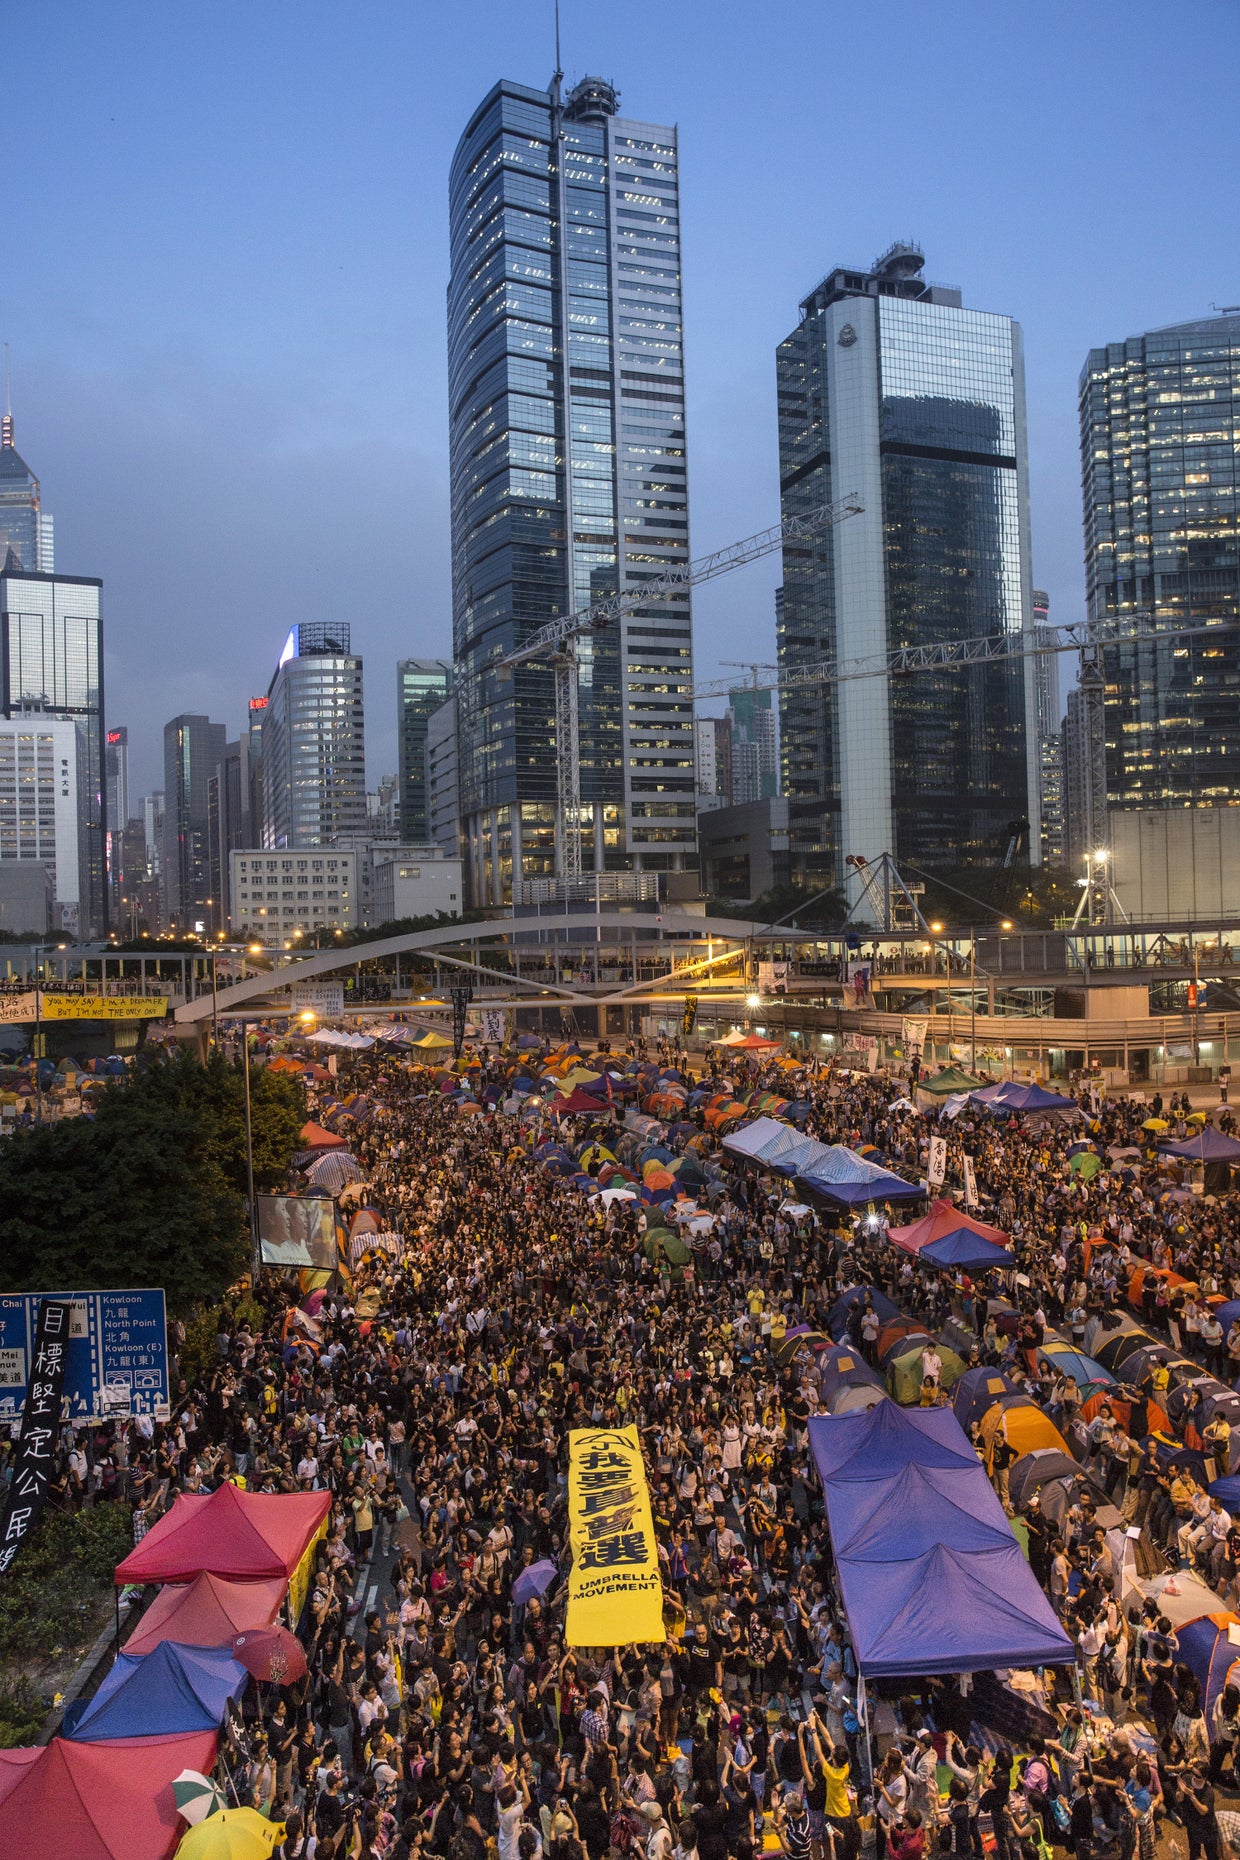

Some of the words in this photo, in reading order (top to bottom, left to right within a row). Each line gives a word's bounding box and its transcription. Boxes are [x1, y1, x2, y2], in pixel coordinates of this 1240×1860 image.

[120, 998, 127, 1006] A
[108, 1008, 124, 1017] THE
[126, 1008, 141, 1017] ONLY
[2, 1300, 23, 1308] Chai
[103, 1296, 142, 1304] Kowloon
[68, 1302, 86, 1310] Wui
[105, 1308, 129, 1319] 九龍
[71, 1323, 82, 1334] 道
[104, 1320, 131, 1329] North
[132, 1319, 157, 1328] Point
[105, 1331, 130, 1343] 北角
[105, 1344, 144, 1353] Kowloon
[146, 1343, 162, 1352] (E)
[2, 1352, 18, 1360] Mei
[579, 1573, 659, 1591] UMBRELLA
[573, 1582, 658, 1600] MOVEMENT
